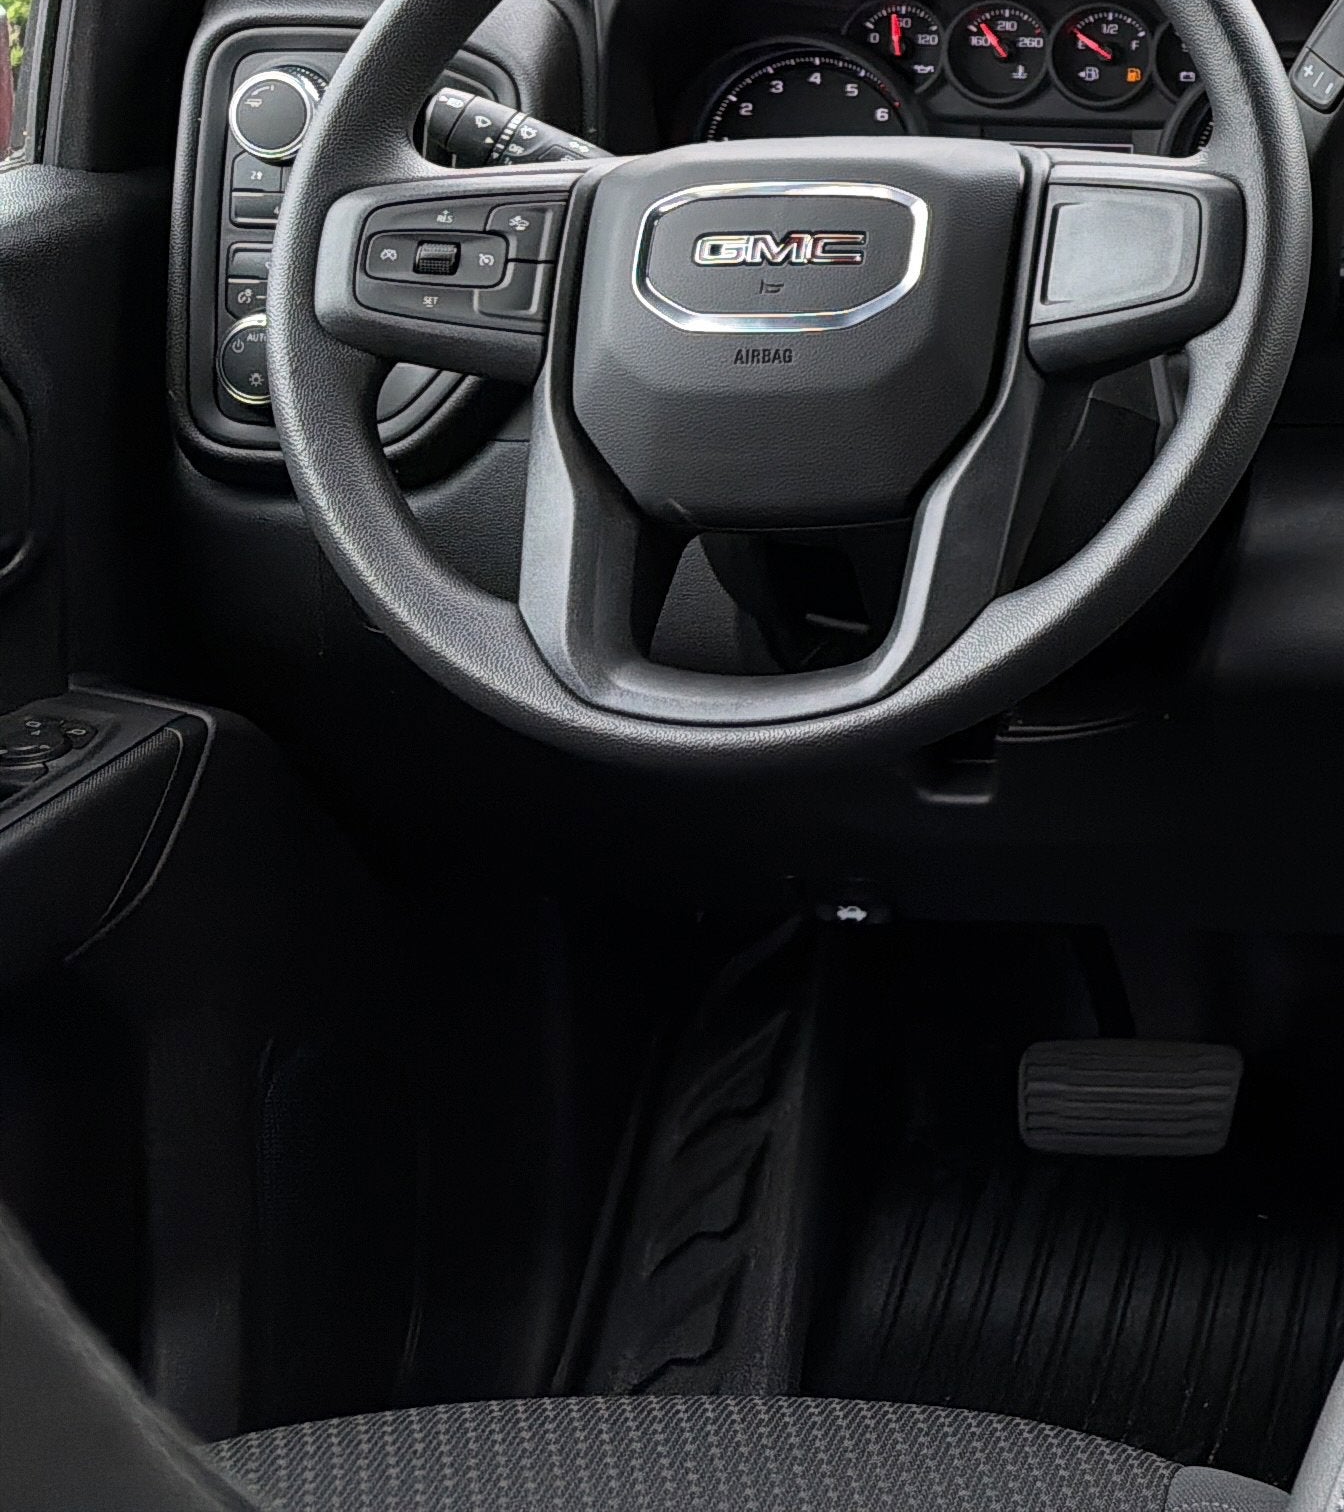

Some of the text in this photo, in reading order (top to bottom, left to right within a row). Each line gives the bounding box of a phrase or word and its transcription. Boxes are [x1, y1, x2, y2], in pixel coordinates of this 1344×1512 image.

[996, 20, 1018, 32] 210
[1101, 23, 1119, 35] 1/2
[869, 32, 880, 44] 0
[917, 34, 939, 45] 120
[979, 35, 1002, 47] 160
[1016, 36, 1044, 48] 260
[1131, 39, 1140, 51] F
[808, 72, 822, 85] 4
[769, 80, 784, 93] 3
[844, 83, 859, 96] 5
[739, 102, 753, 116] 2
[874, 108, 889, 121] 6
[692, 231, 867, 267] GMC
[423, 296, 440, 305] SET
[734, 348, 793, 365] AIRBAG
